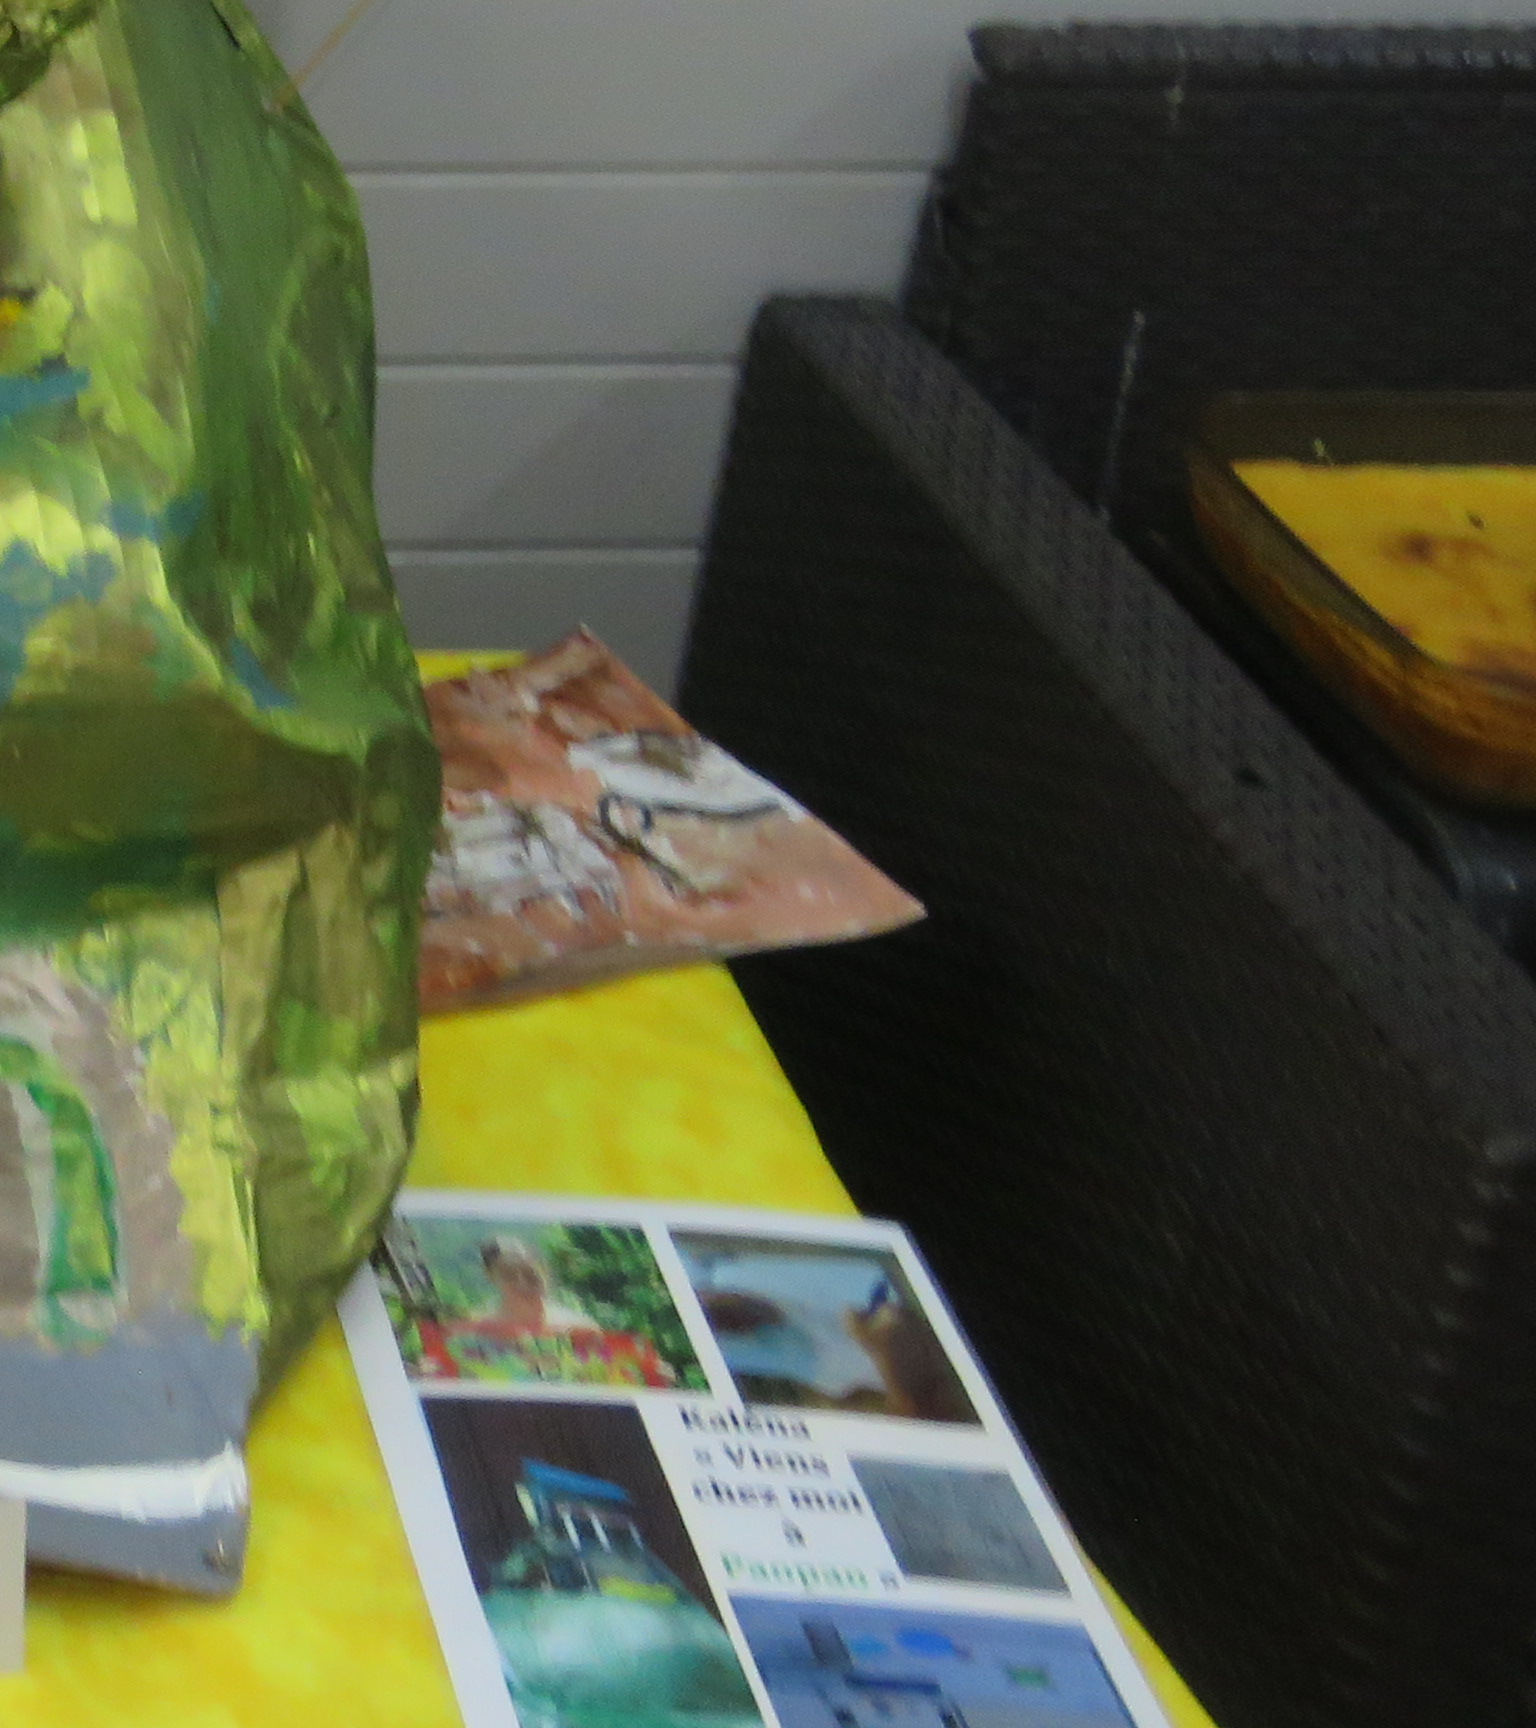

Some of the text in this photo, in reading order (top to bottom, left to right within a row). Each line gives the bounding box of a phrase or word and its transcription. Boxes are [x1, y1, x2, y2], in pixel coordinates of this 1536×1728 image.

[722, 1441, 831, 1478] Viens
[690, 1474, 865, 1515] chez moi
